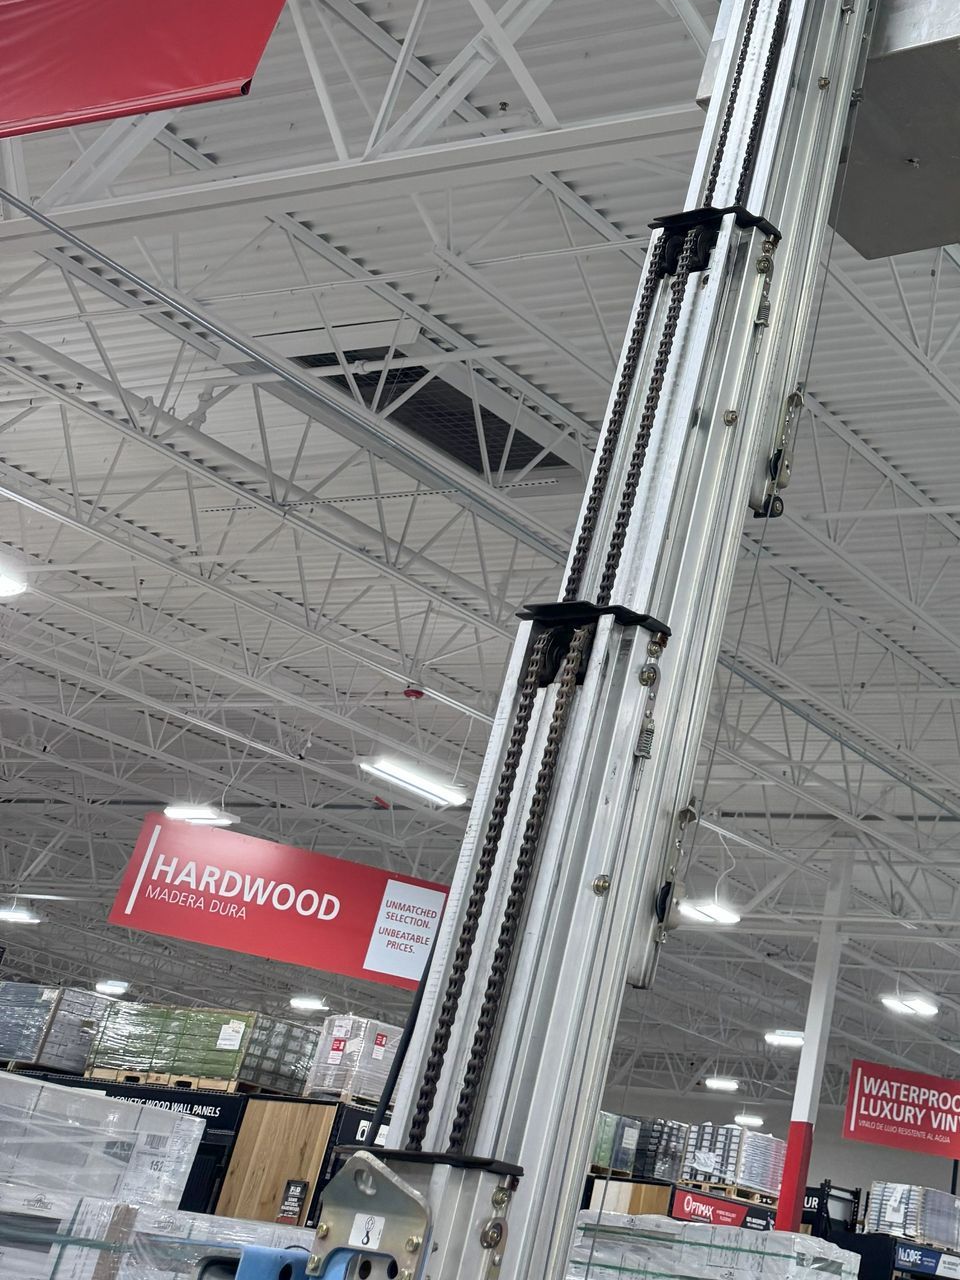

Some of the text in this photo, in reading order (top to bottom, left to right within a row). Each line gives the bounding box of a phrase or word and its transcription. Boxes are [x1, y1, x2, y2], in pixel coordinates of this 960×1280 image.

[151, 854, 341, 921] HARDWOOD
[145, 885, 246, 920] MADERA DURA
[385, 899, 438, 919] UNMATCHED
[385, 911, 431, 929] SELECTION.
[378, 926, 431, 946] UNBEATABLE
[385, 939, 415, 954] PRICES.
[146, 1099, 170, 1111] WOOD
[170, 1100, 191, 1114] WALL
[191, 1104, 221, 1118] PANELS
[860, 1096, 926, 1126] LUXURY
[876, 1121, 884, 1131] DE
[683, 1195, 714, 1220] OPTIMAX
[803, 1196, 819, 1209] UR
